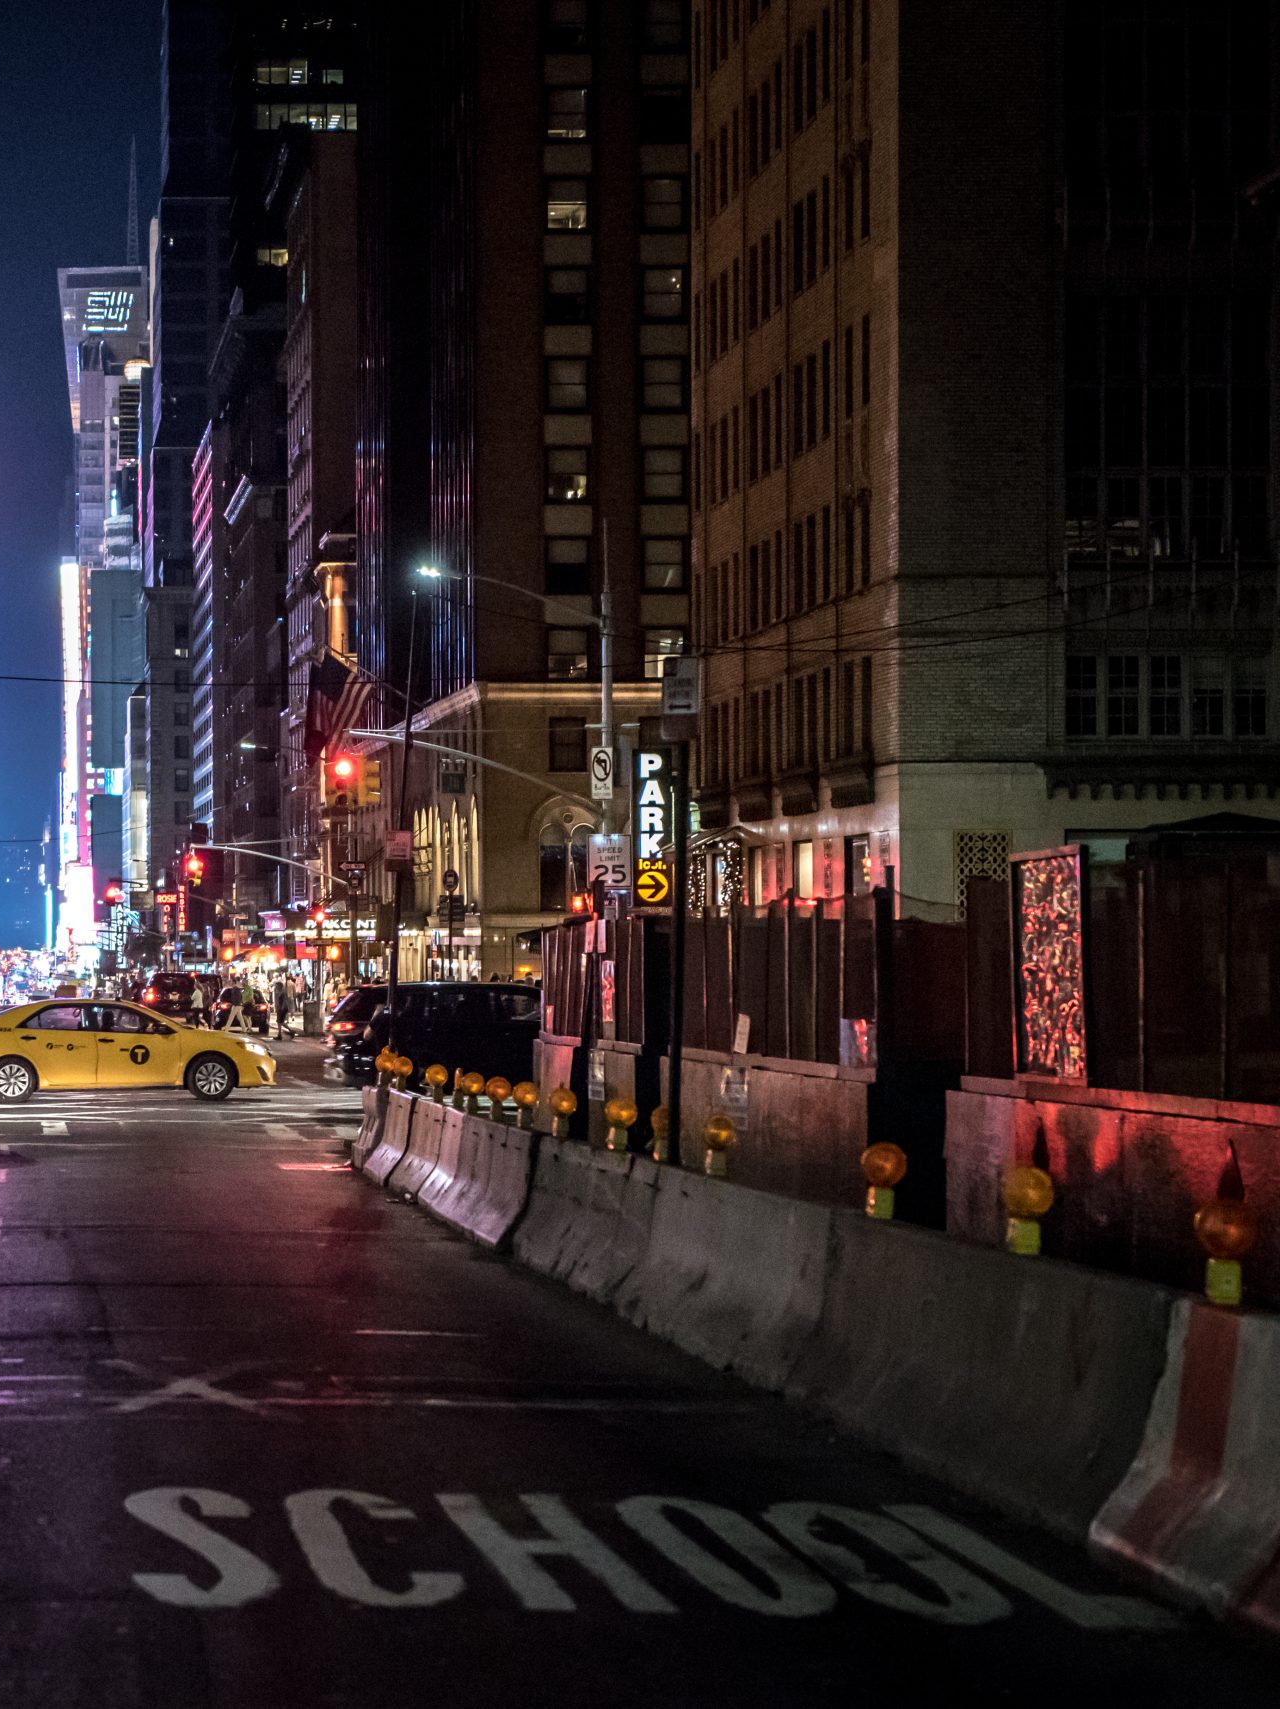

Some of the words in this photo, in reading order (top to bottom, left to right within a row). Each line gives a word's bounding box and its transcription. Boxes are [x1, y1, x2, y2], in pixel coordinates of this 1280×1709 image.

[639, 753, 665, 859] PARK
[596, 846, 623, 854] SPEED
[594, 864, 626, 884] 25
[134, 1049, 146, 1063] T
[122, 1486, 1184, 1633] SCHOOL
